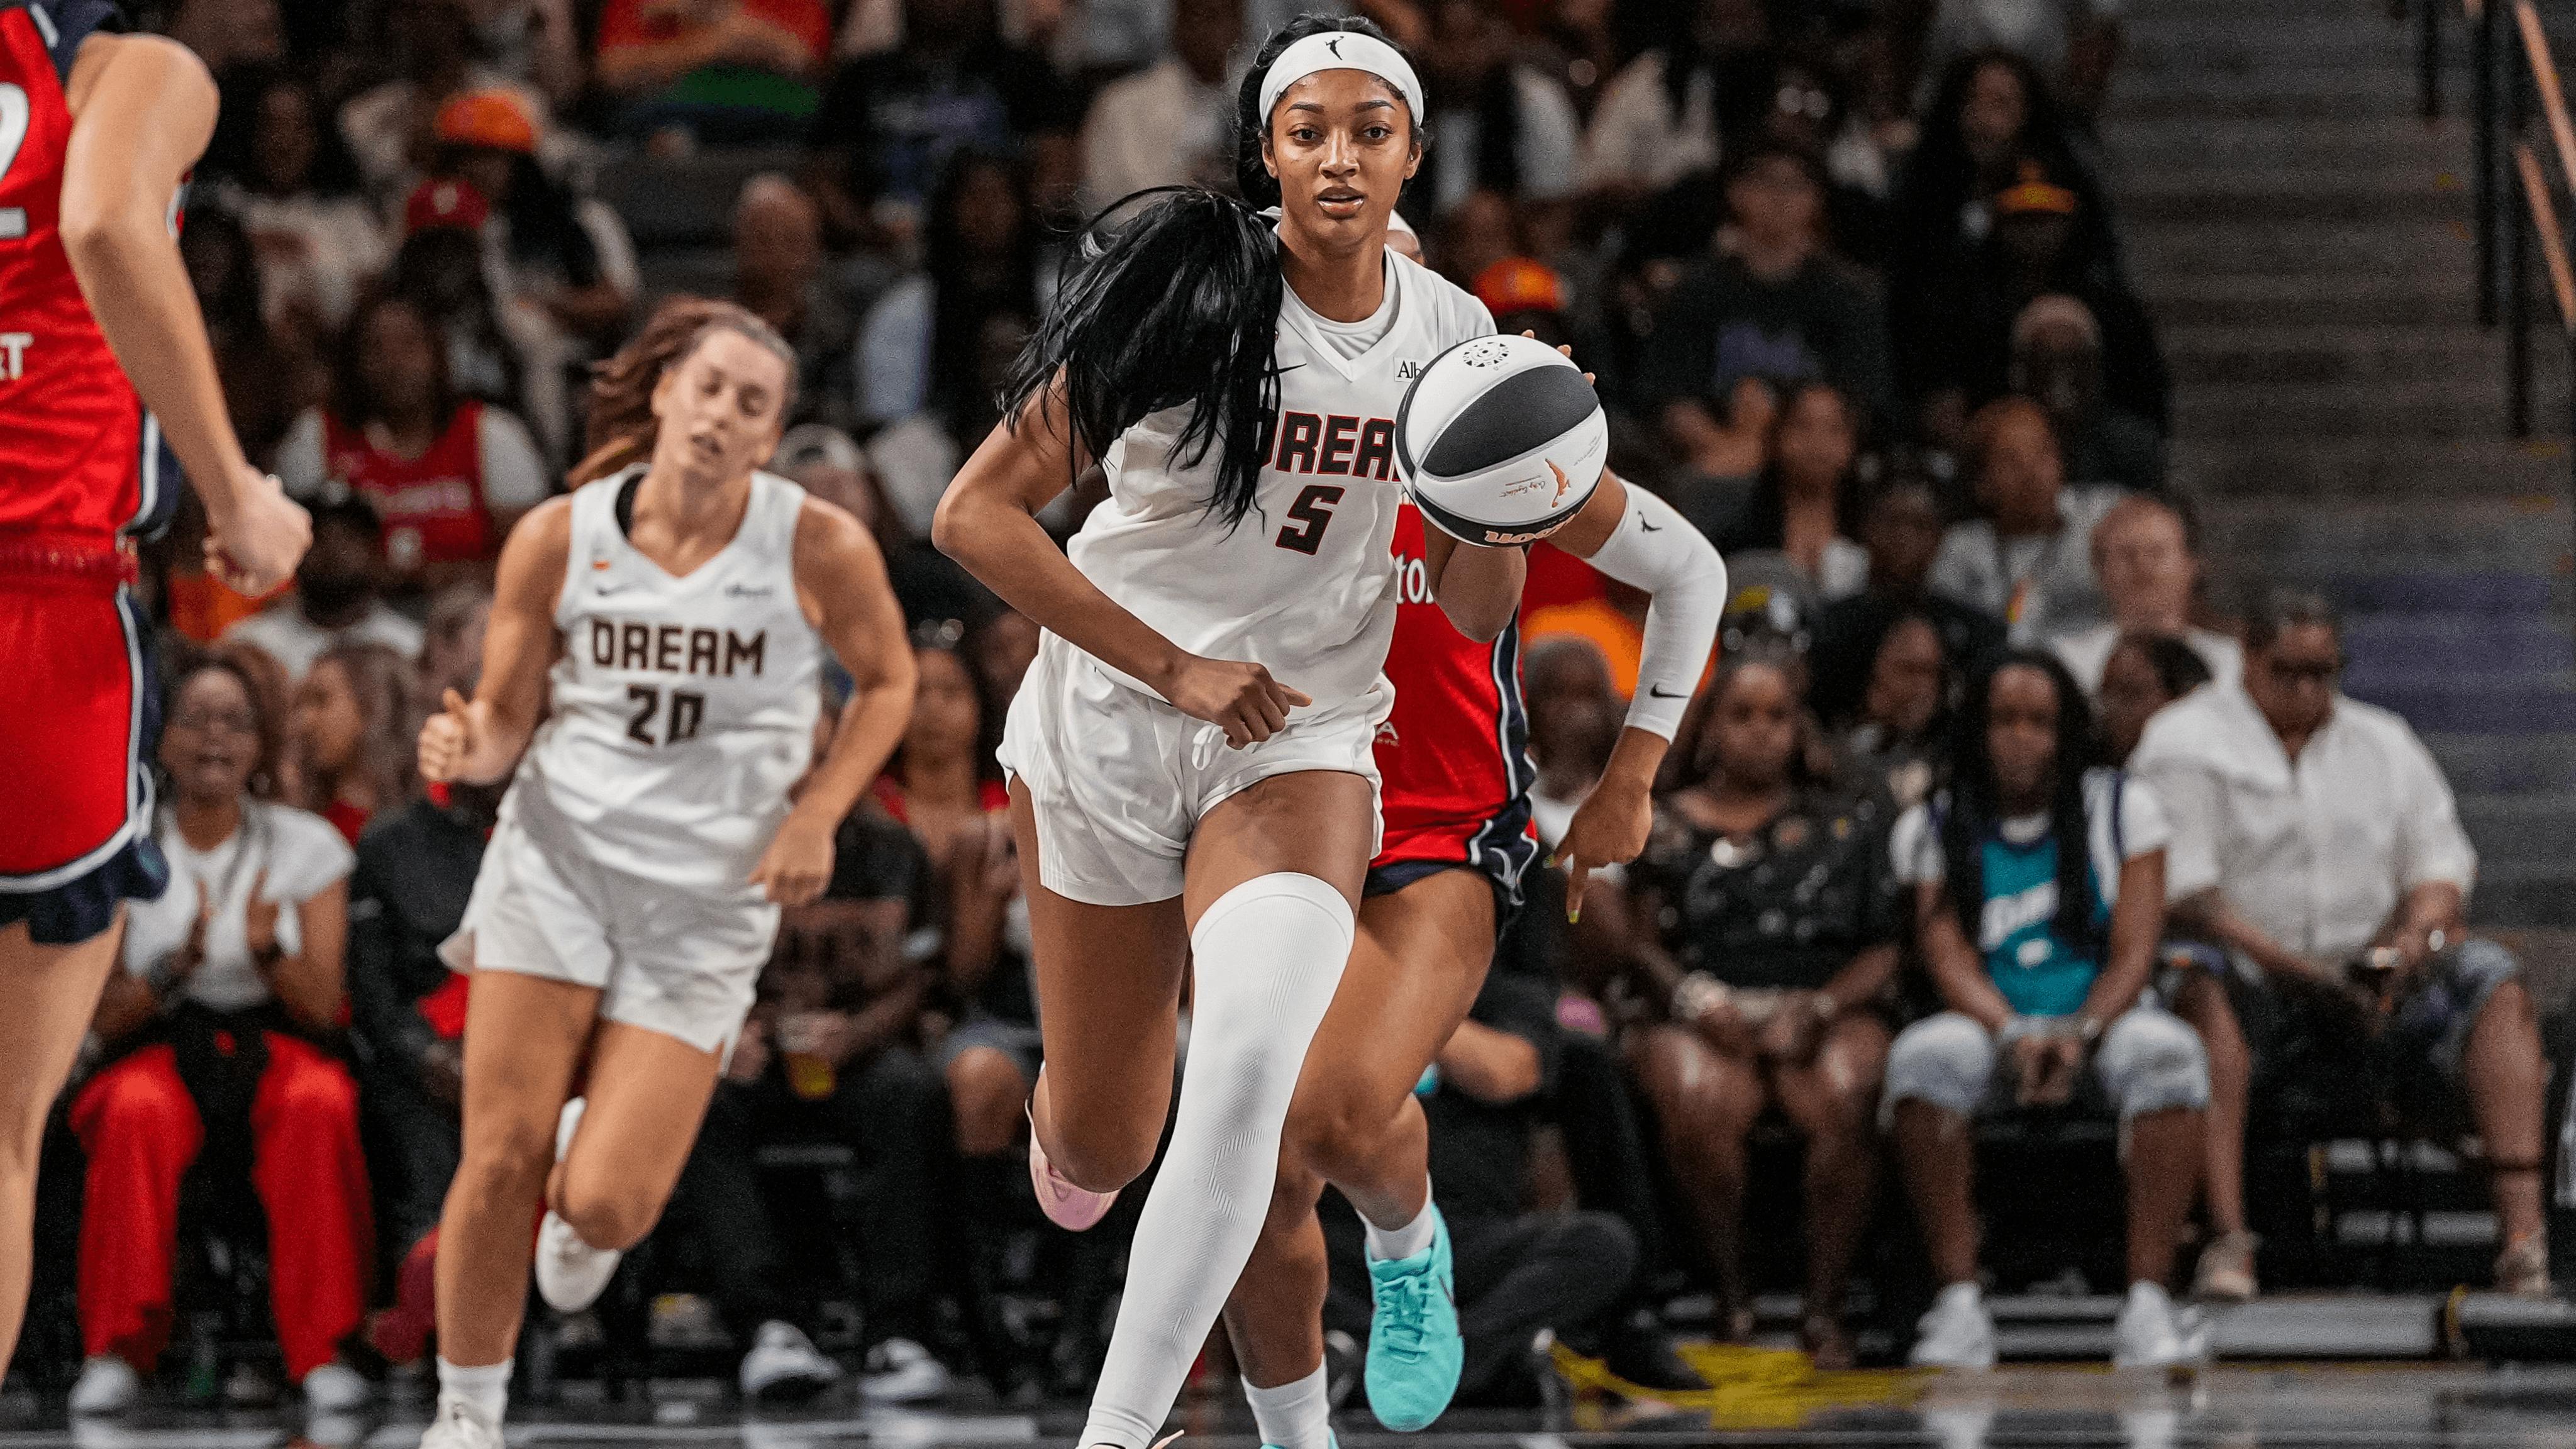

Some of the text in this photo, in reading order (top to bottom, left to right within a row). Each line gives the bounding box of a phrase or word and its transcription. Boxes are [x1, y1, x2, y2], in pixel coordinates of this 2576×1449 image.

[1260, 410, 1402, 482] REA
[1275, 484, 1346, 556] 5
[1394, 552, 1435, 604] to
[592, 618, 767, 677] DREAM
[626, 684, 705, 745] 20
